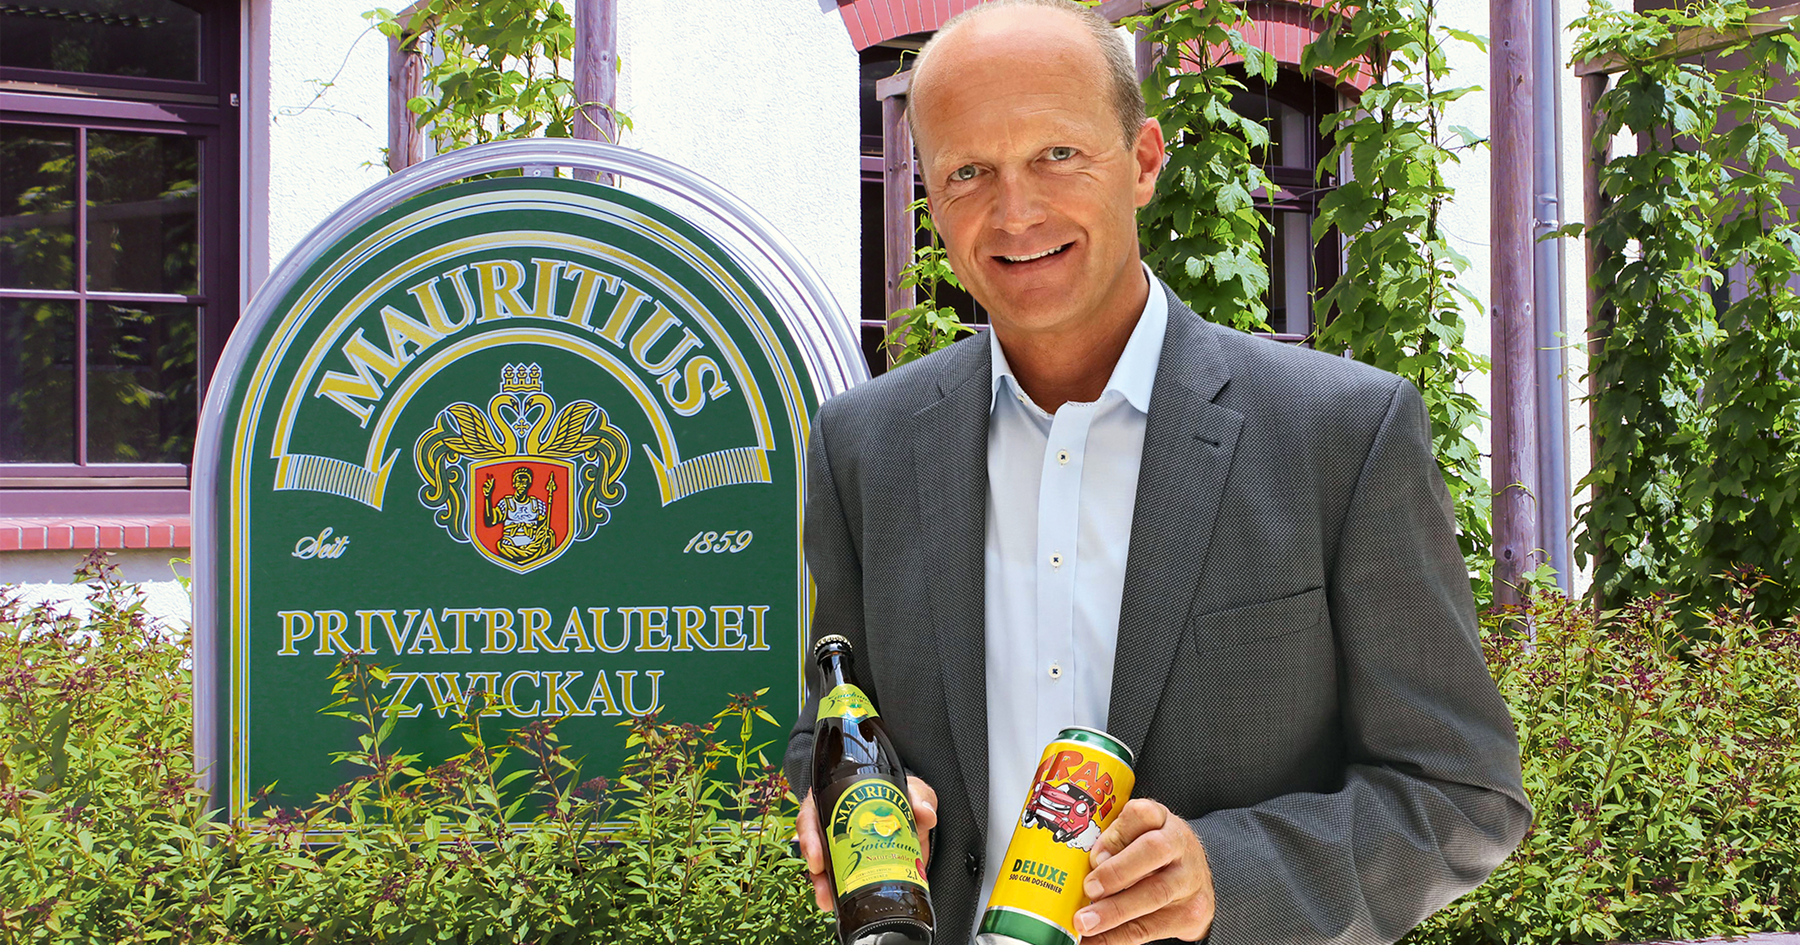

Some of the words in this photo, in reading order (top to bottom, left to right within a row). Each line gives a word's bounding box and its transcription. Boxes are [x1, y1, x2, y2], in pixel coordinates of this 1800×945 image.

[314, 257, 732, 430] MAURITIUS
[291, 526, 350, 560] Seit
[683, 529, 754, 555] 1859
[277, 604, 771, 657] PRIVATBRAUEREI
[381, 669, 665, 719] ZWICKAU
[835, 784, 914, 826] MAURITIUS
[842, 837, 921, 882] Zwickauer
[1012, 859, 1068, 887] DELUXE
[1009, 873, 1019, 881] 500
[1019, 874, 1031, 883] CCM
[1031, 877, 1063, 895] DOSENBIER
